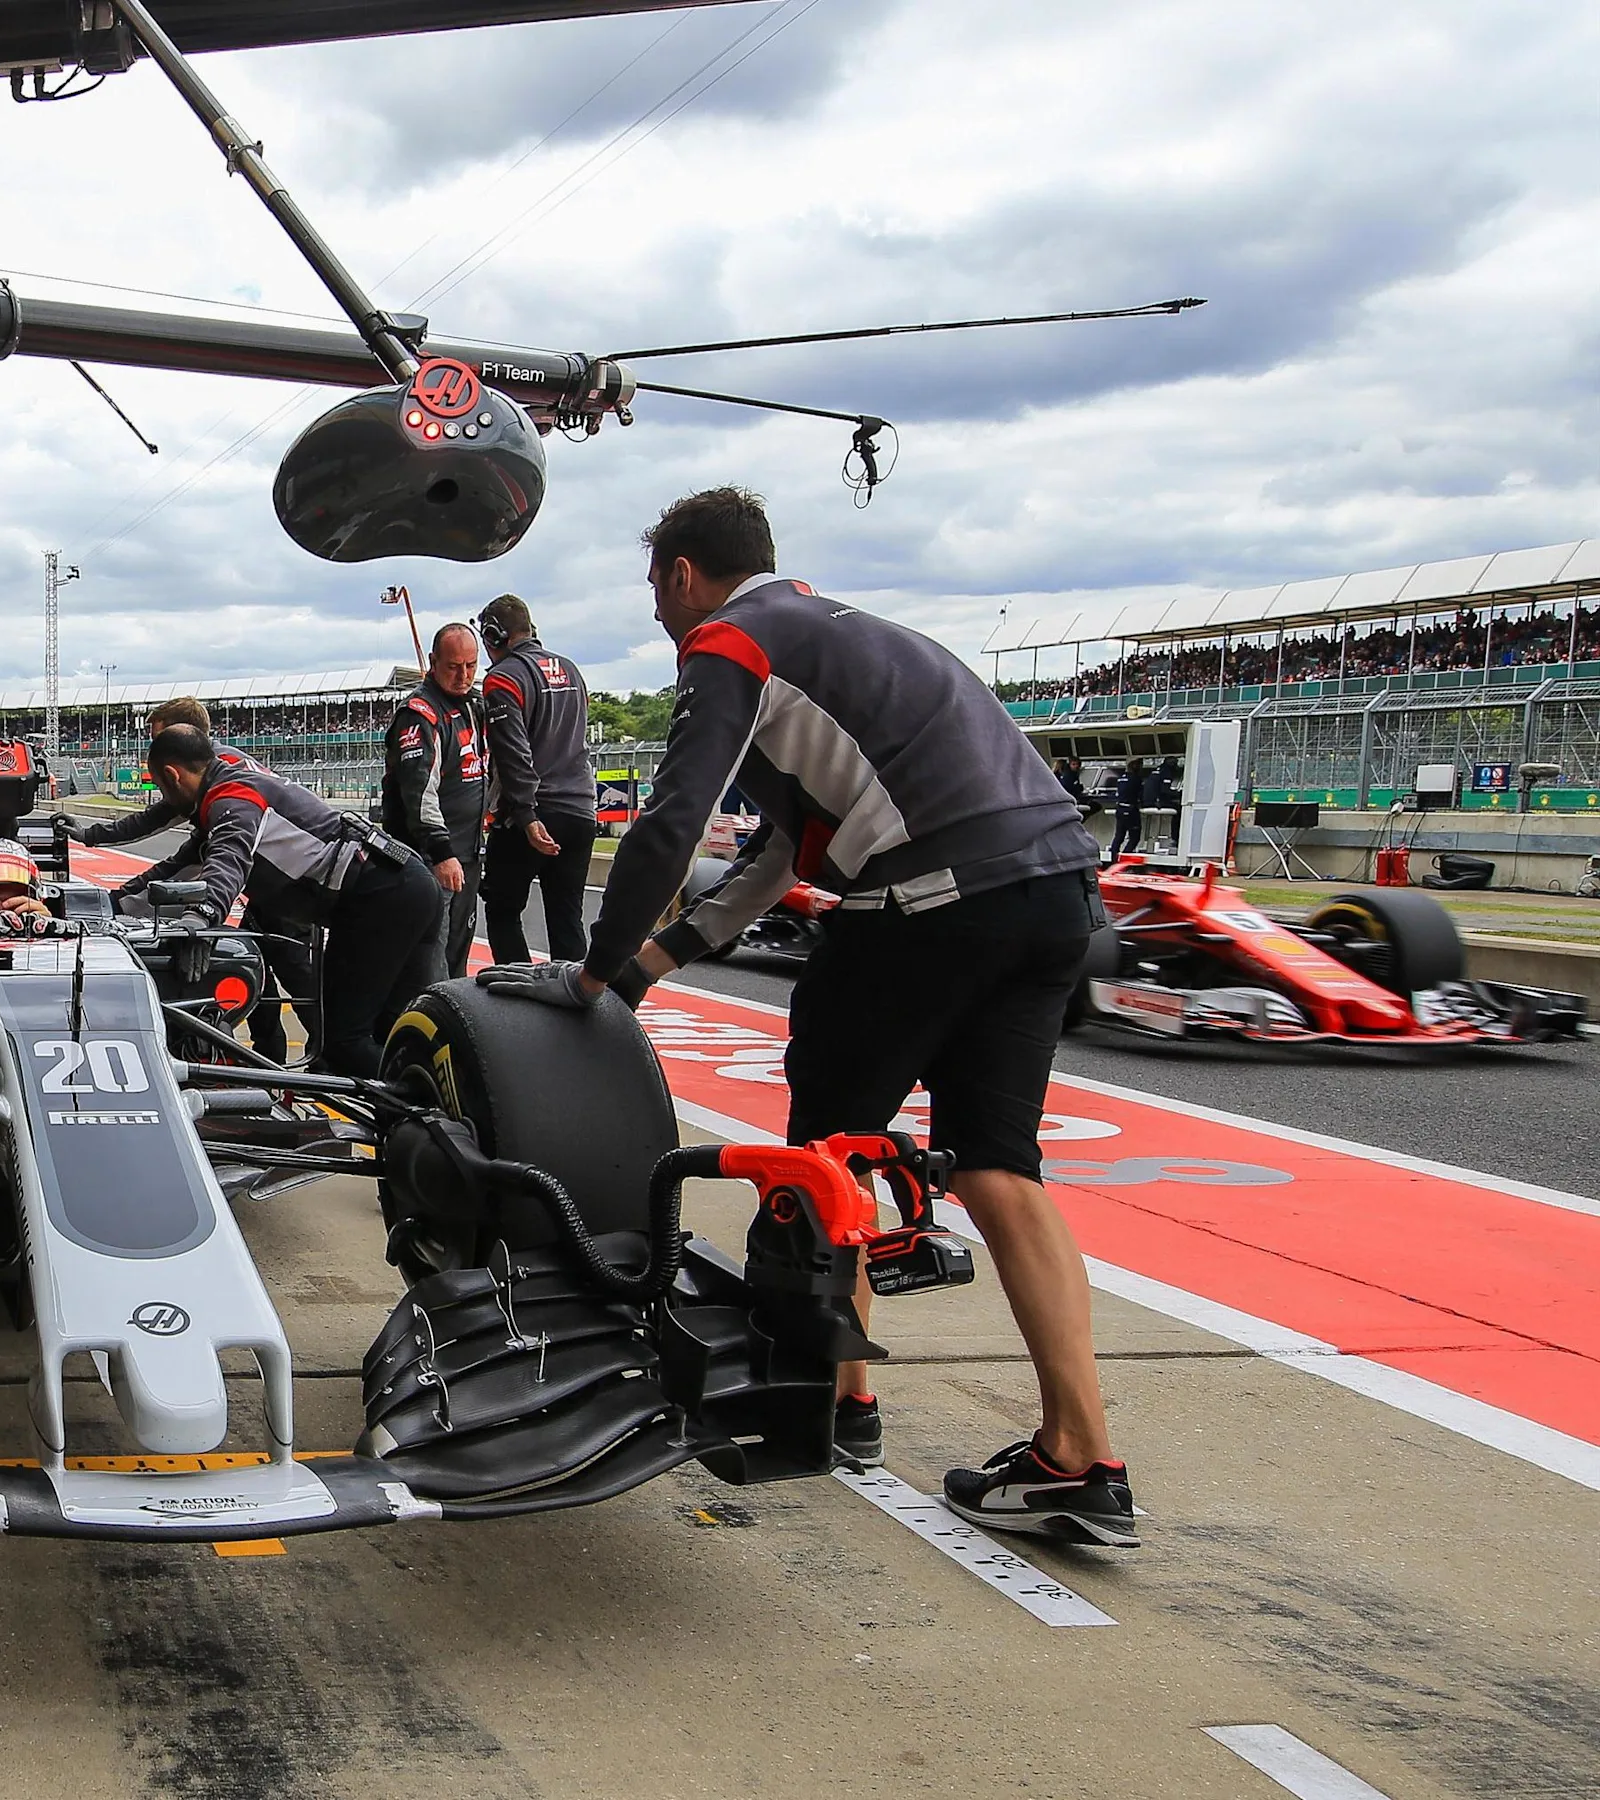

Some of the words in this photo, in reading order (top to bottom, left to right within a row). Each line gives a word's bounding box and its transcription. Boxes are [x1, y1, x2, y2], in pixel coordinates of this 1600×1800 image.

[481, 361, 499, 378] F1
[502, 363, 545, 383] Team
[33, 1040, 150, 1093] 20
[48, 1110, 160, 1125] PIRELLI
[876, 1477, 903, 1489] 10
[181, 1497, 236, 1505] ACTION
[951, 1526, 981, 1540] 10
[990, 1553, 1029, 1570] 20
[1034, 1583, 1074, 1600] 30
